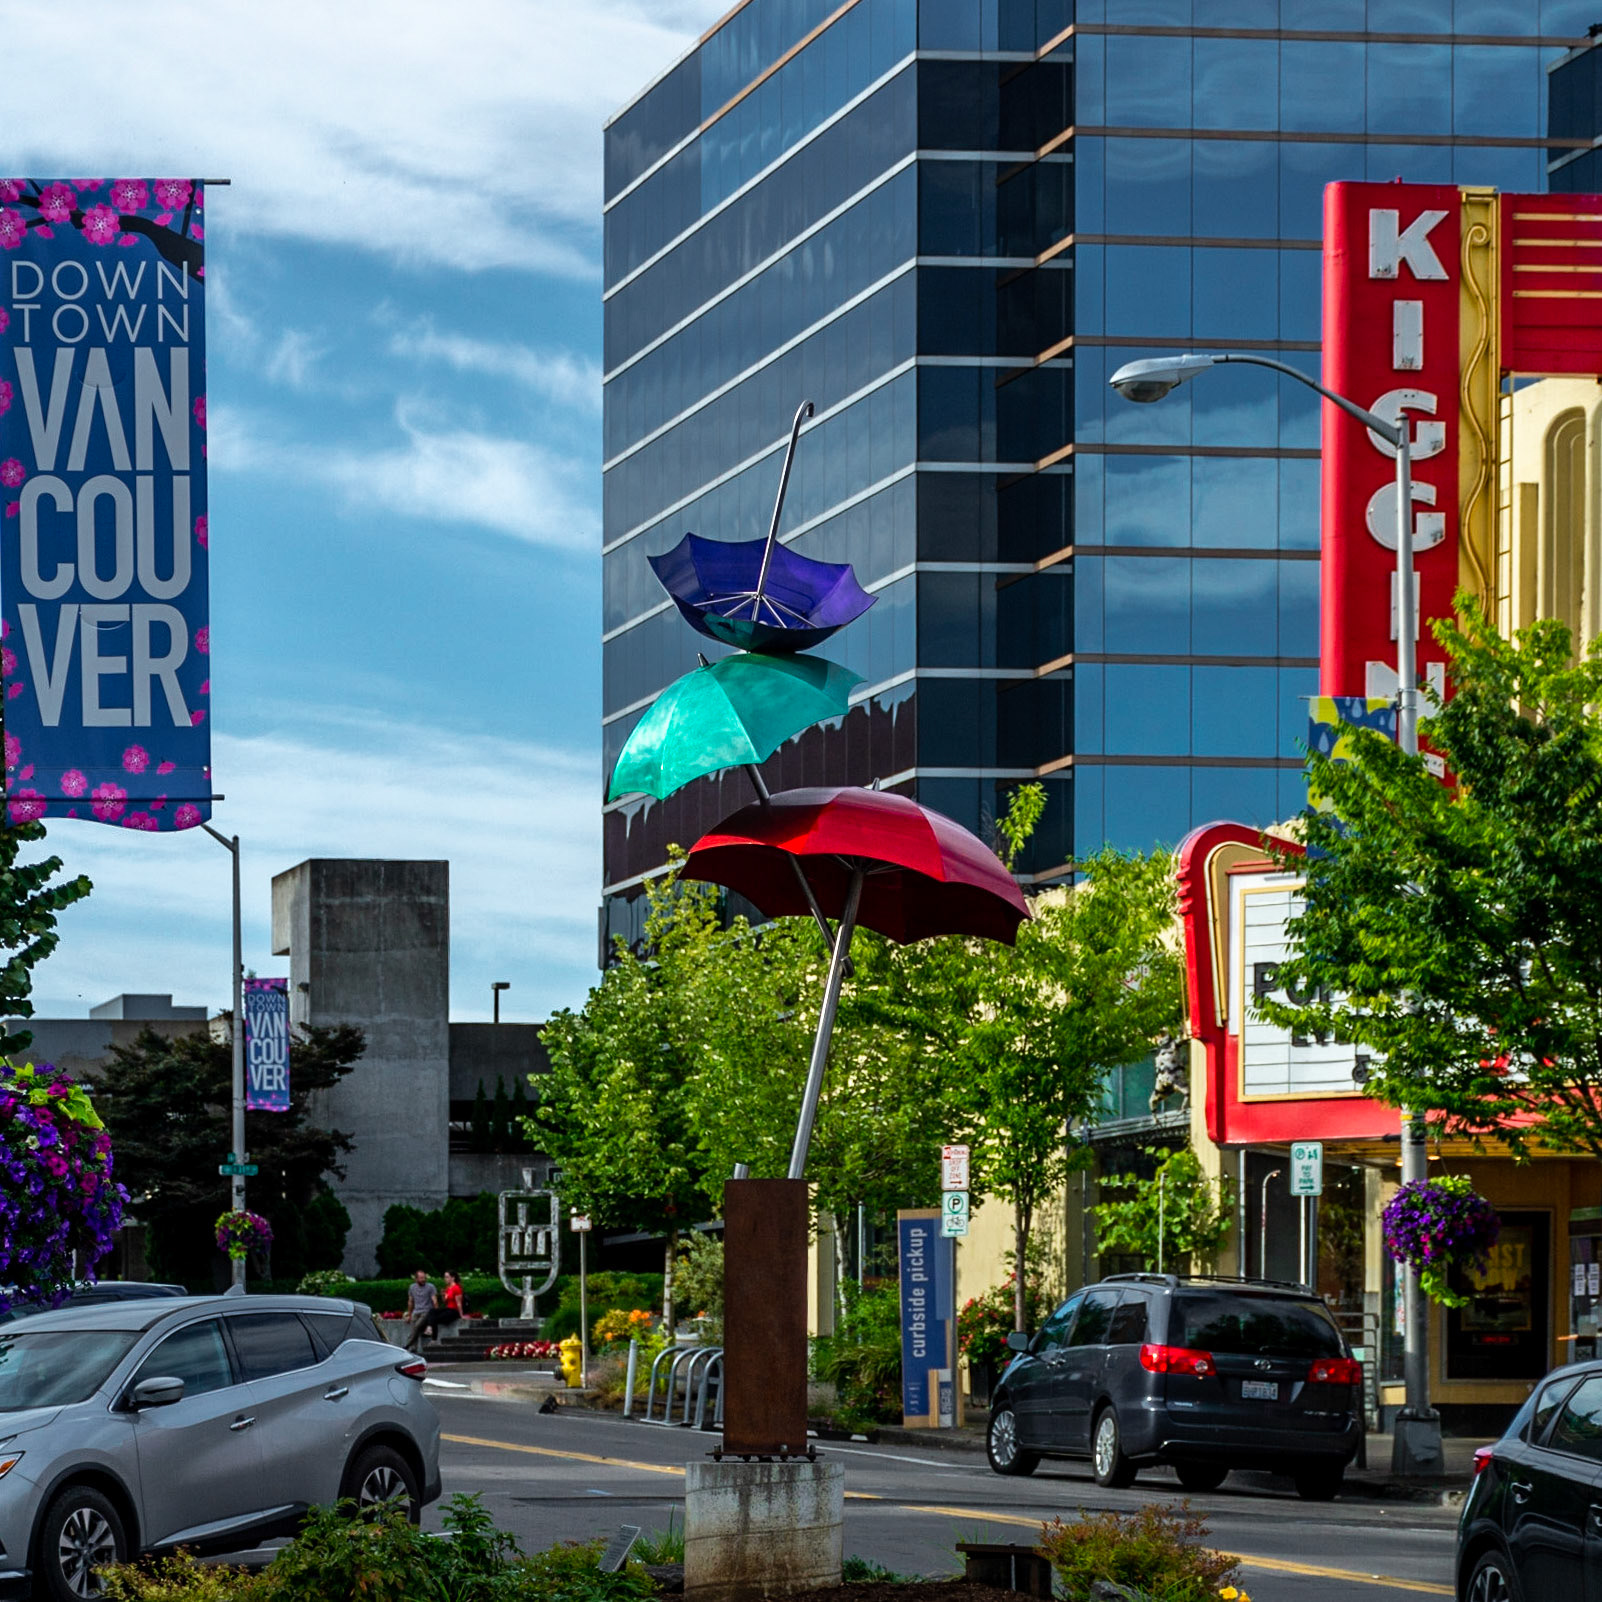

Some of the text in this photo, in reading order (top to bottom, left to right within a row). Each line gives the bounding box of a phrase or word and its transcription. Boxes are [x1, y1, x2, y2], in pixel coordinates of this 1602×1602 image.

[11, 259, 190, 301] DOWN
[12, 303, 190, 343] TOWN
[13, 346, 191, 472] VAN
[1366, 208, 1450, 778] KIGGIN
[19, 474, 191, 600] COU
[17, 603, 193, 727] VER
[247, 994, 286, 1003] DOWN
[248, 1002, 286, 1012] TOWN
[248, 1011, 286, 1038] VAN
[249, 1038, 286, 1064] COU
[249, 1064, 287, 1091] VER
[906, 1227, 928, 1282] pickup
[907, 1287, 926, 1358] curbside
